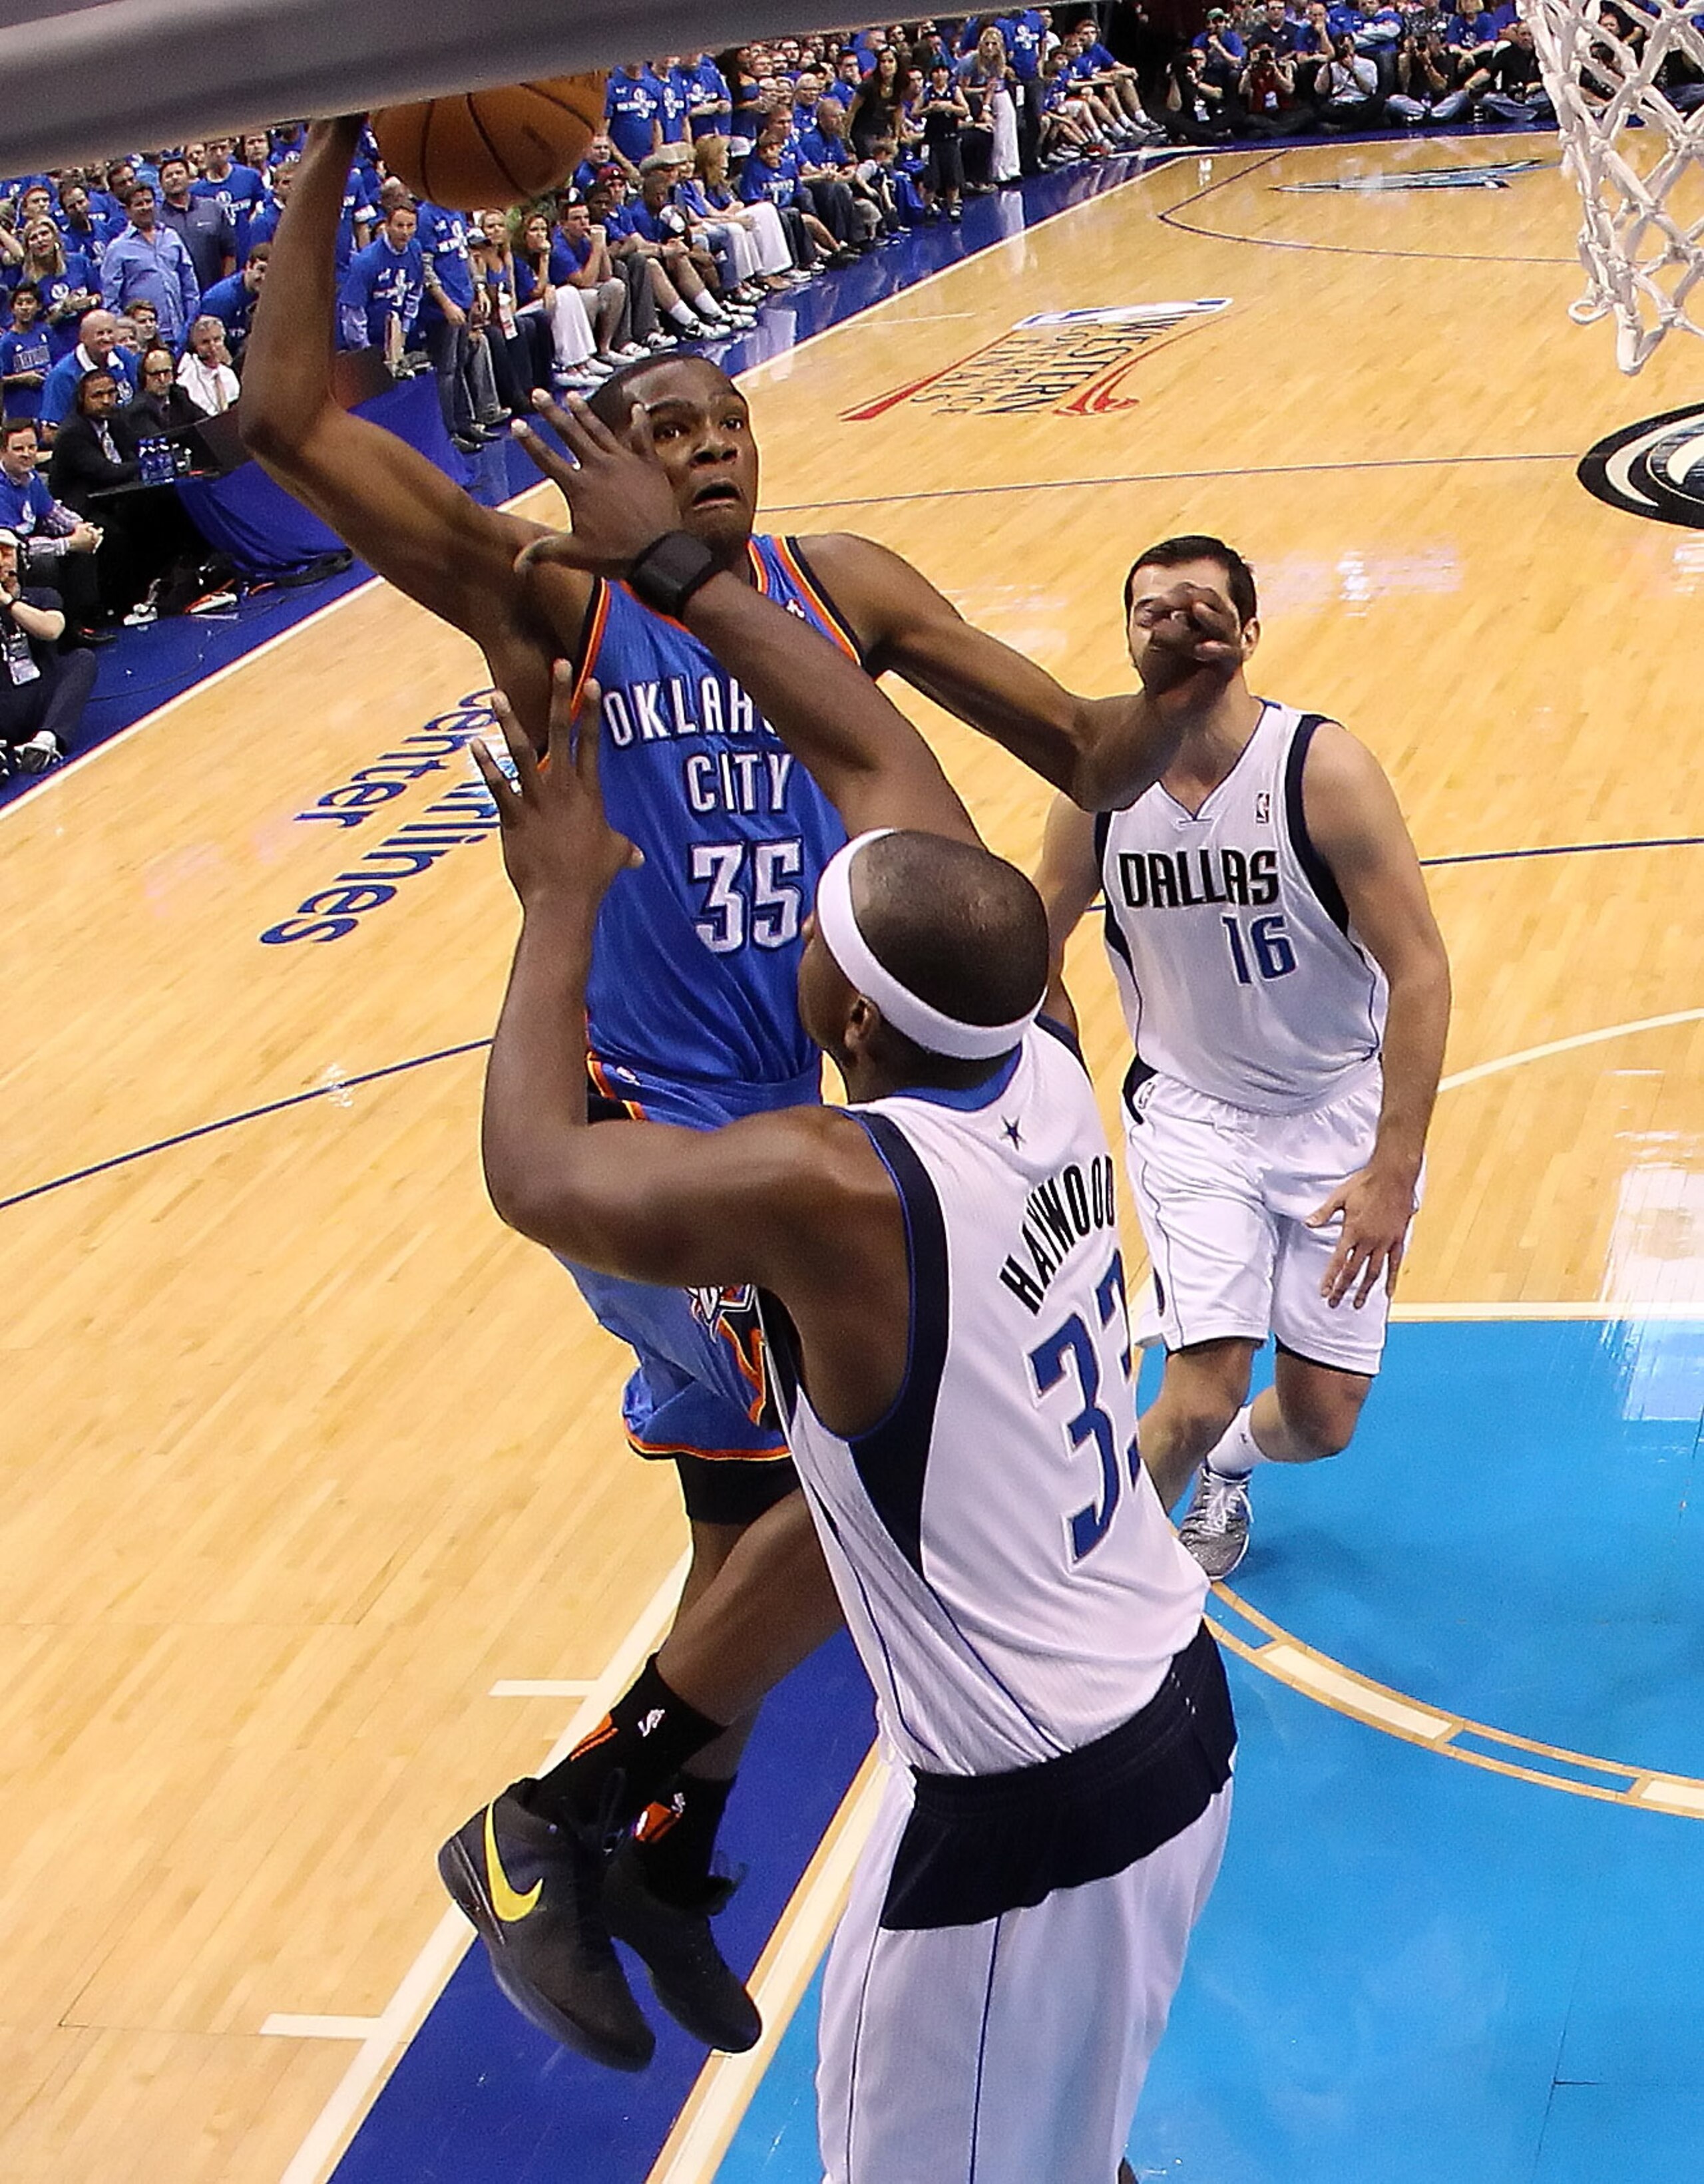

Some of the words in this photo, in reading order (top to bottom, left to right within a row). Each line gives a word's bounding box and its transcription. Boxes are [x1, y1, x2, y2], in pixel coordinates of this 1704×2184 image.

[910, 338, 1041, 403] FINALS
[971, 315, 1189, 415] WESTERN
[601, 674, 777, 749] OKLAH
[686, 752, 795, 815] CITY
[688, 838, 803, 953] 35
[1117, 847, 1279, 909] DALLAS
[1221, 912, 1299, 985] 16
